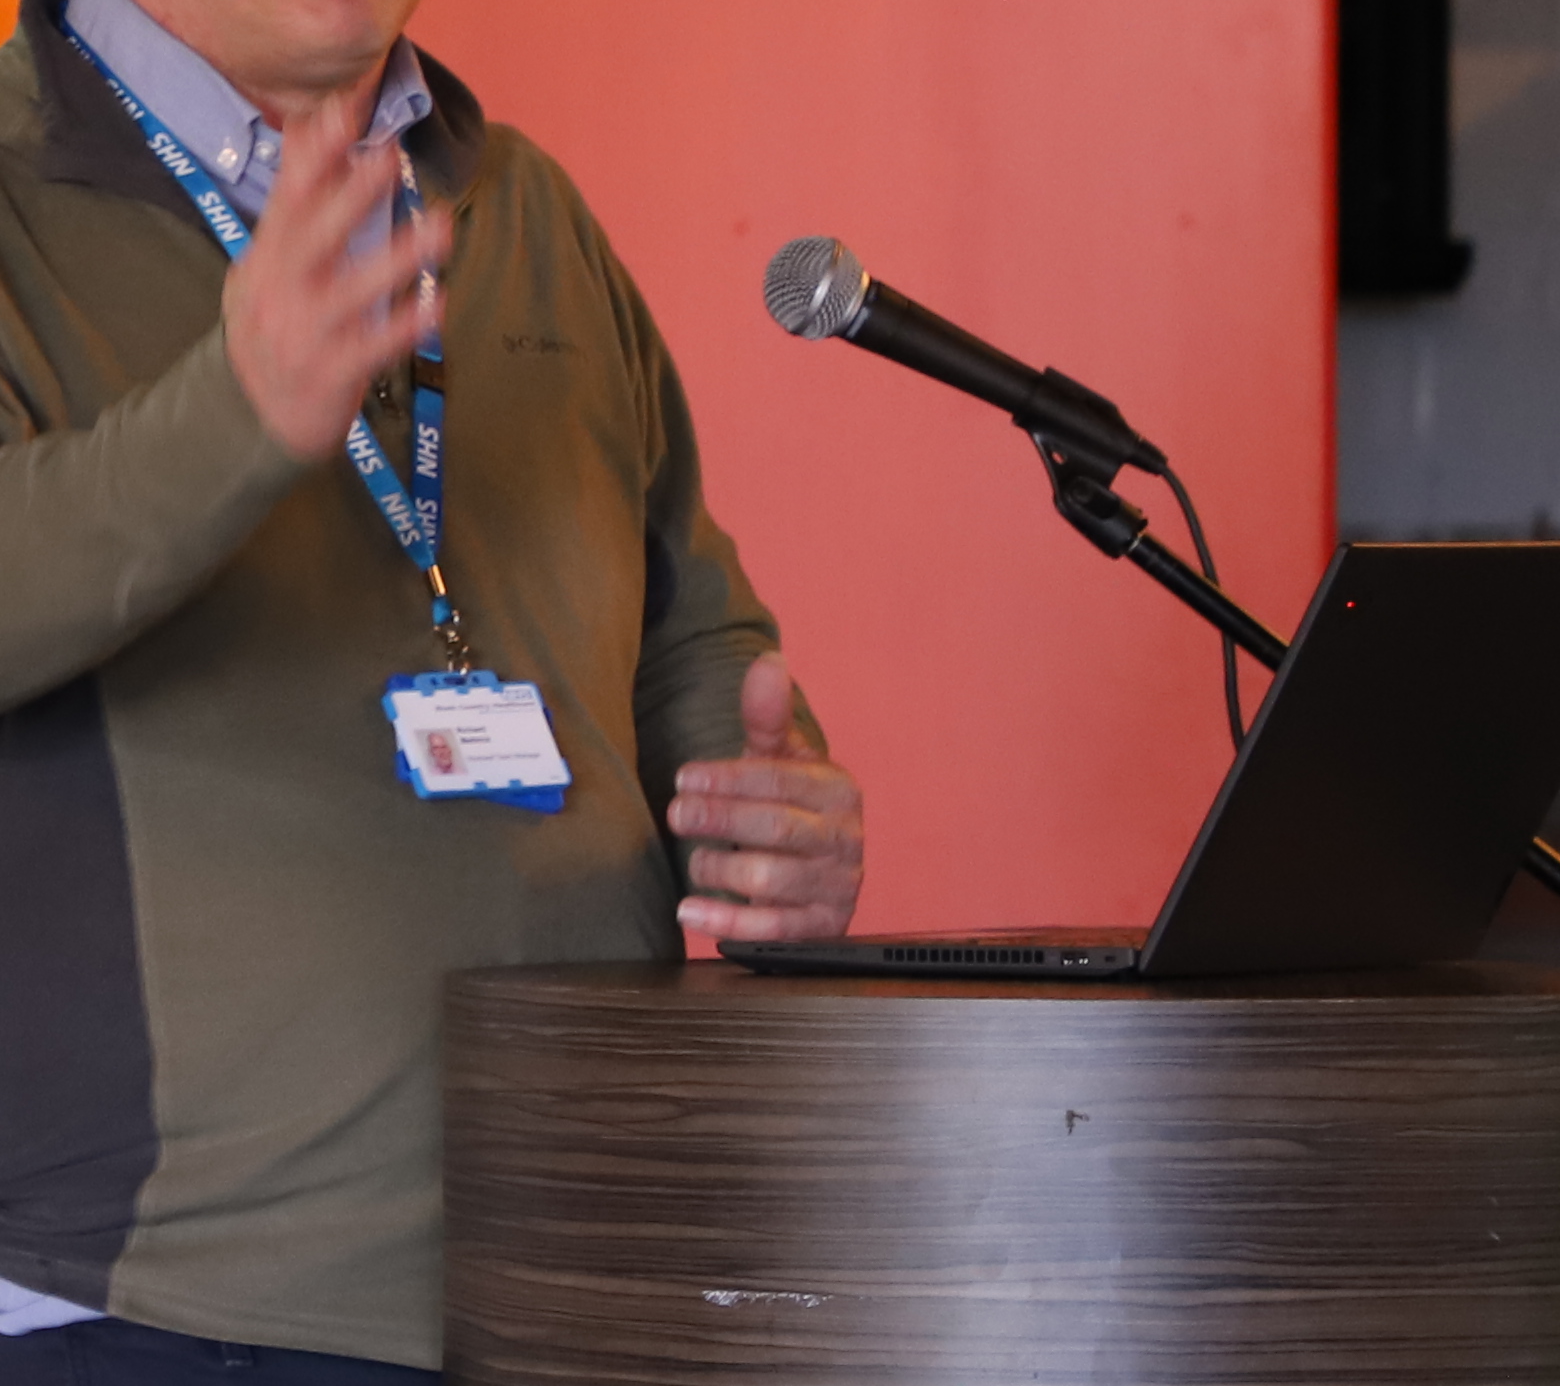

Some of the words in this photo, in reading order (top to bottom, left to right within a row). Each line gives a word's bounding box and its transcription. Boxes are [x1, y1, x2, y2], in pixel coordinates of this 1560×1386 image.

[146, 131, 196, 177] NHS
[196, 190, 245, 243] NHS
[415, 421, 440, 479] NHS
[380, 491, 422, 547] NHS
